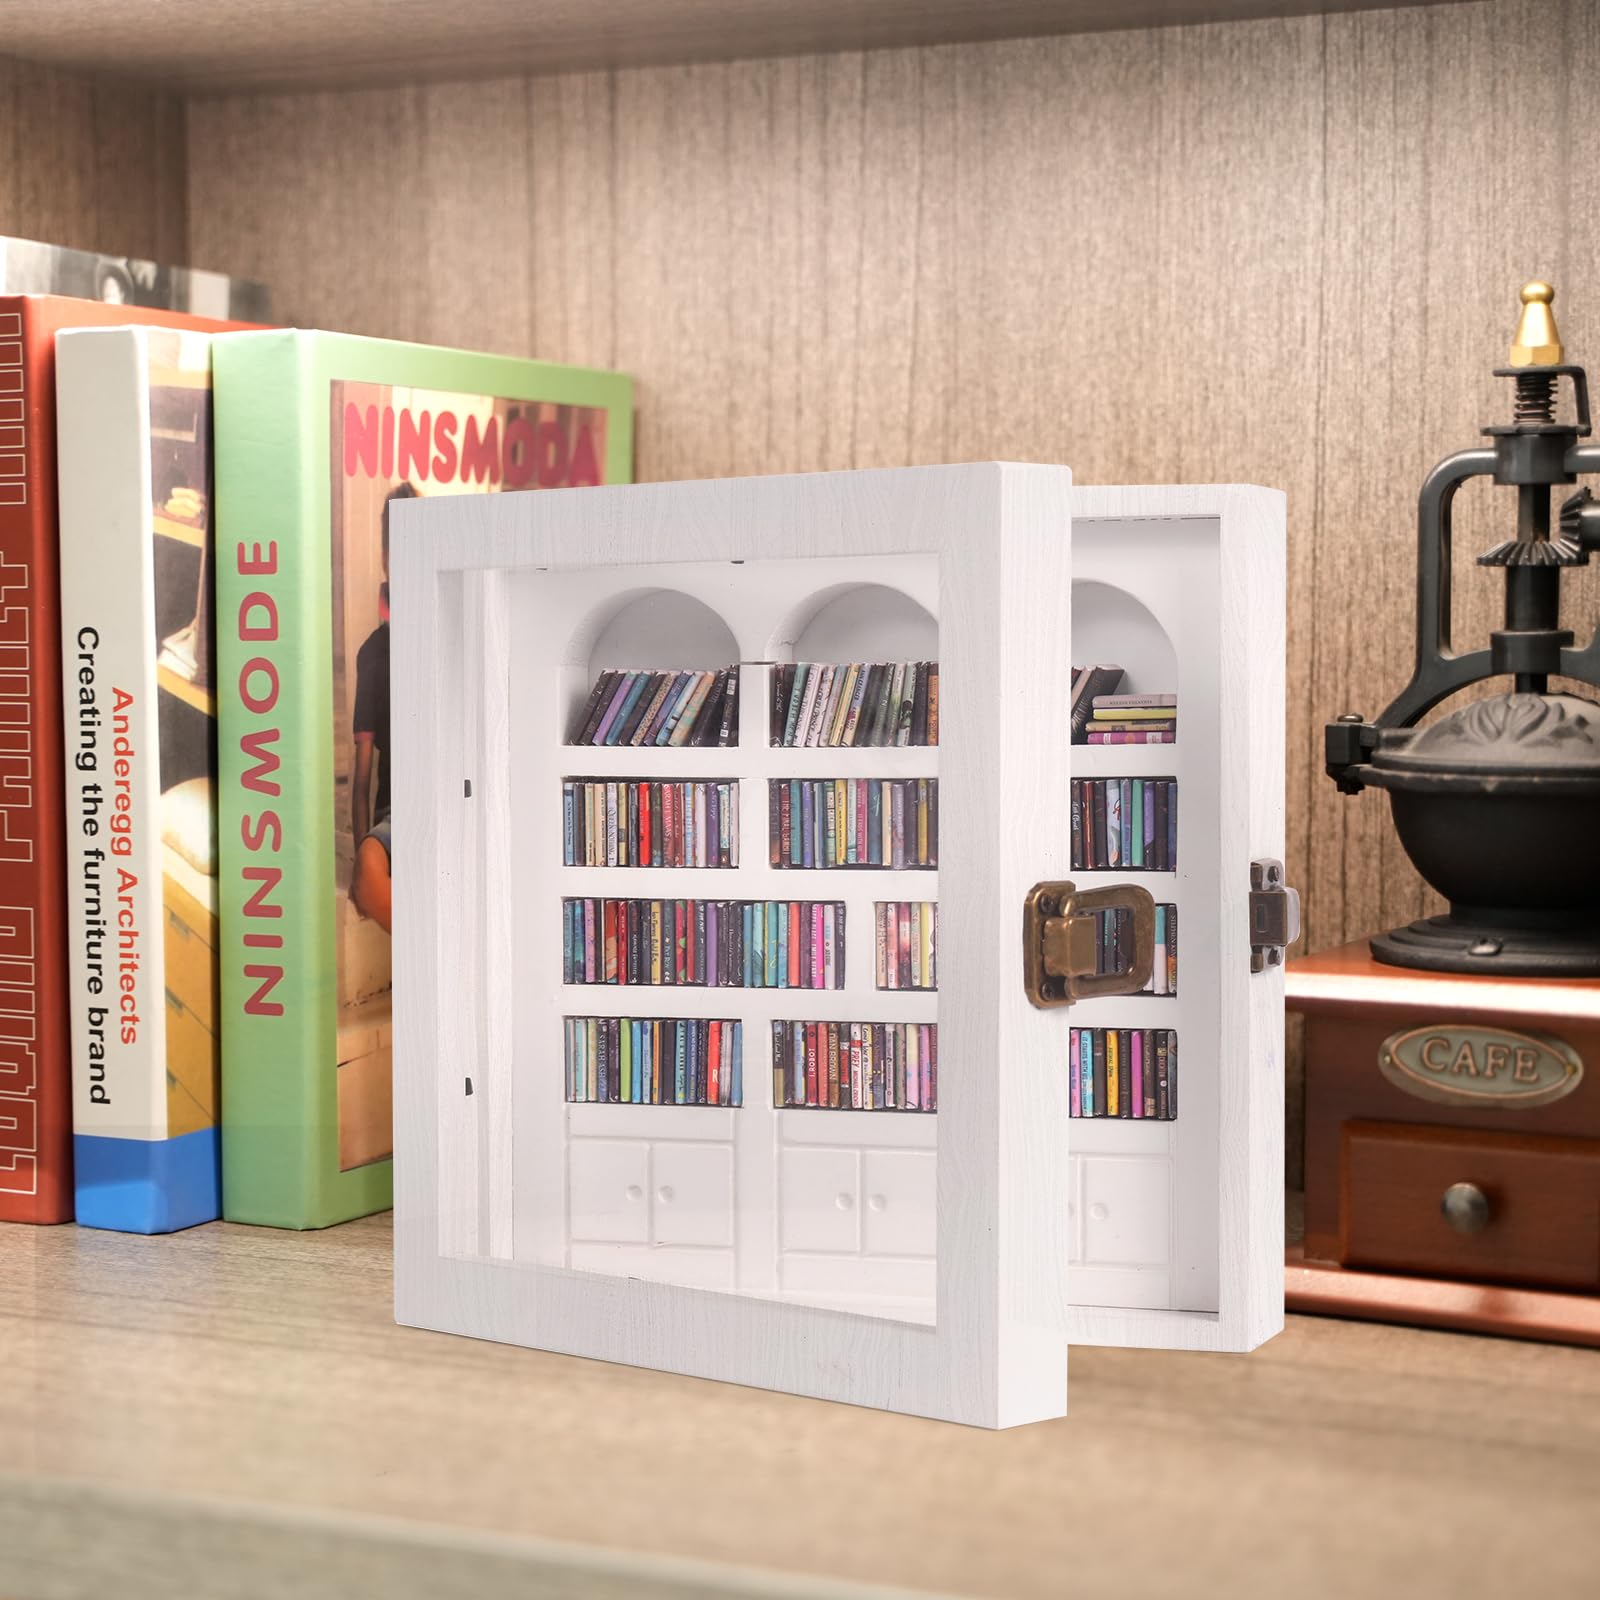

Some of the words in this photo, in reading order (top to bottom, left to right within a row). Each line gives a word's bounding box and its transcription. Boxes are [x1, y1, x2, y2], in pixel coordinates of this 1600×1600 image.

[344, 402, 601, 486] NINSMODA
[75, 626, 102, 772] Creating
[110, 687, 135, 856] Anderegg
[82, 783, 104, 836] the
[237, 540, 284, 1017] NINSMODE
[83, 848, 107, 995] furniture
[117, 868, 140, 1045] Architects
[88, 1007, 111, 1105] brand
[1420, 1036, 1541, 1083] CAFE
